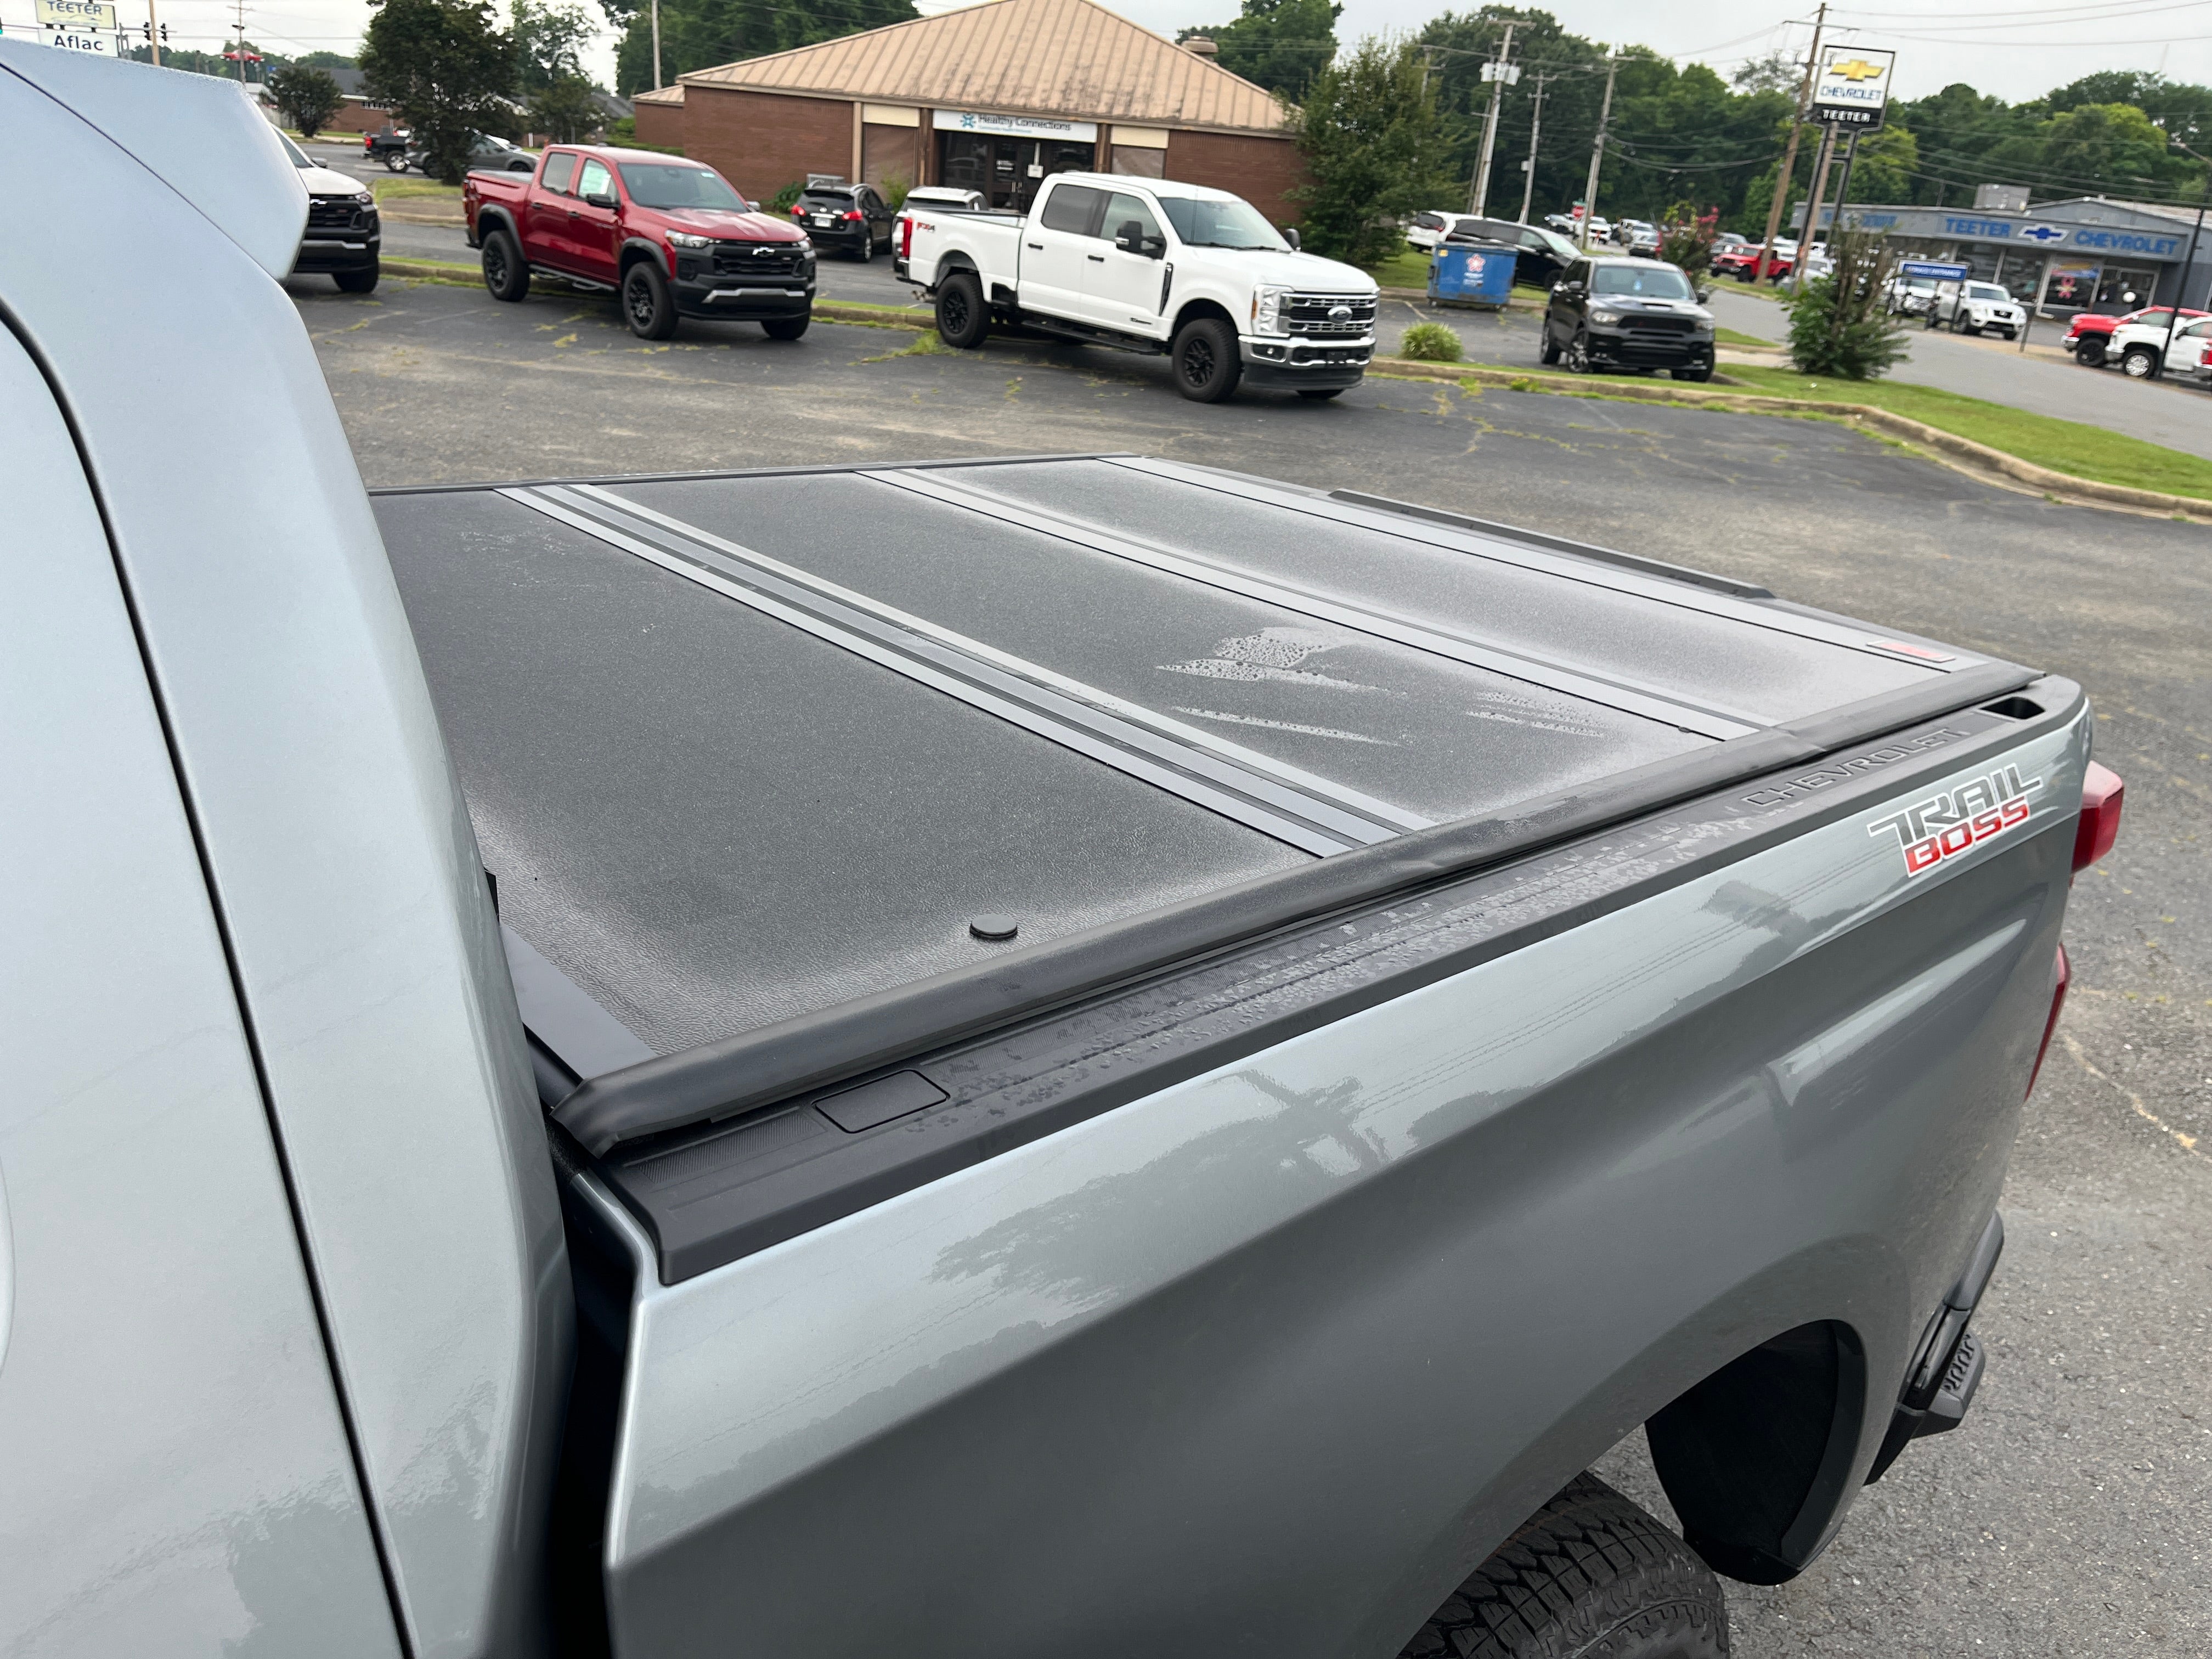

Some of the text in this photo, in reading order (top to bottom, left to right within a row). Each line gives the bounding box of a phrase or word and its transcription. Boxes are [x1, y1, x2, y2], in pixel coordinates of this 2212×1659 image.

[47, 1, 102, 15] TEETER
[55, 35, 103, 50] Aflac
[1820, 85, 1882, 100] CHEVROLET
[978, 114, 1013, 127] Healthy
[1015, 117, 1072, 131] Connections
[1822, 109, 1871, 123] TEETER
[1945, 218, 2178, 255] TEETER CHEVROLET
[1739, 726, 1971, 808] CHEVROLET
[1866, 762, 2043, 847] TRAIL
[1904, 795, 2032, 877] BOSS
